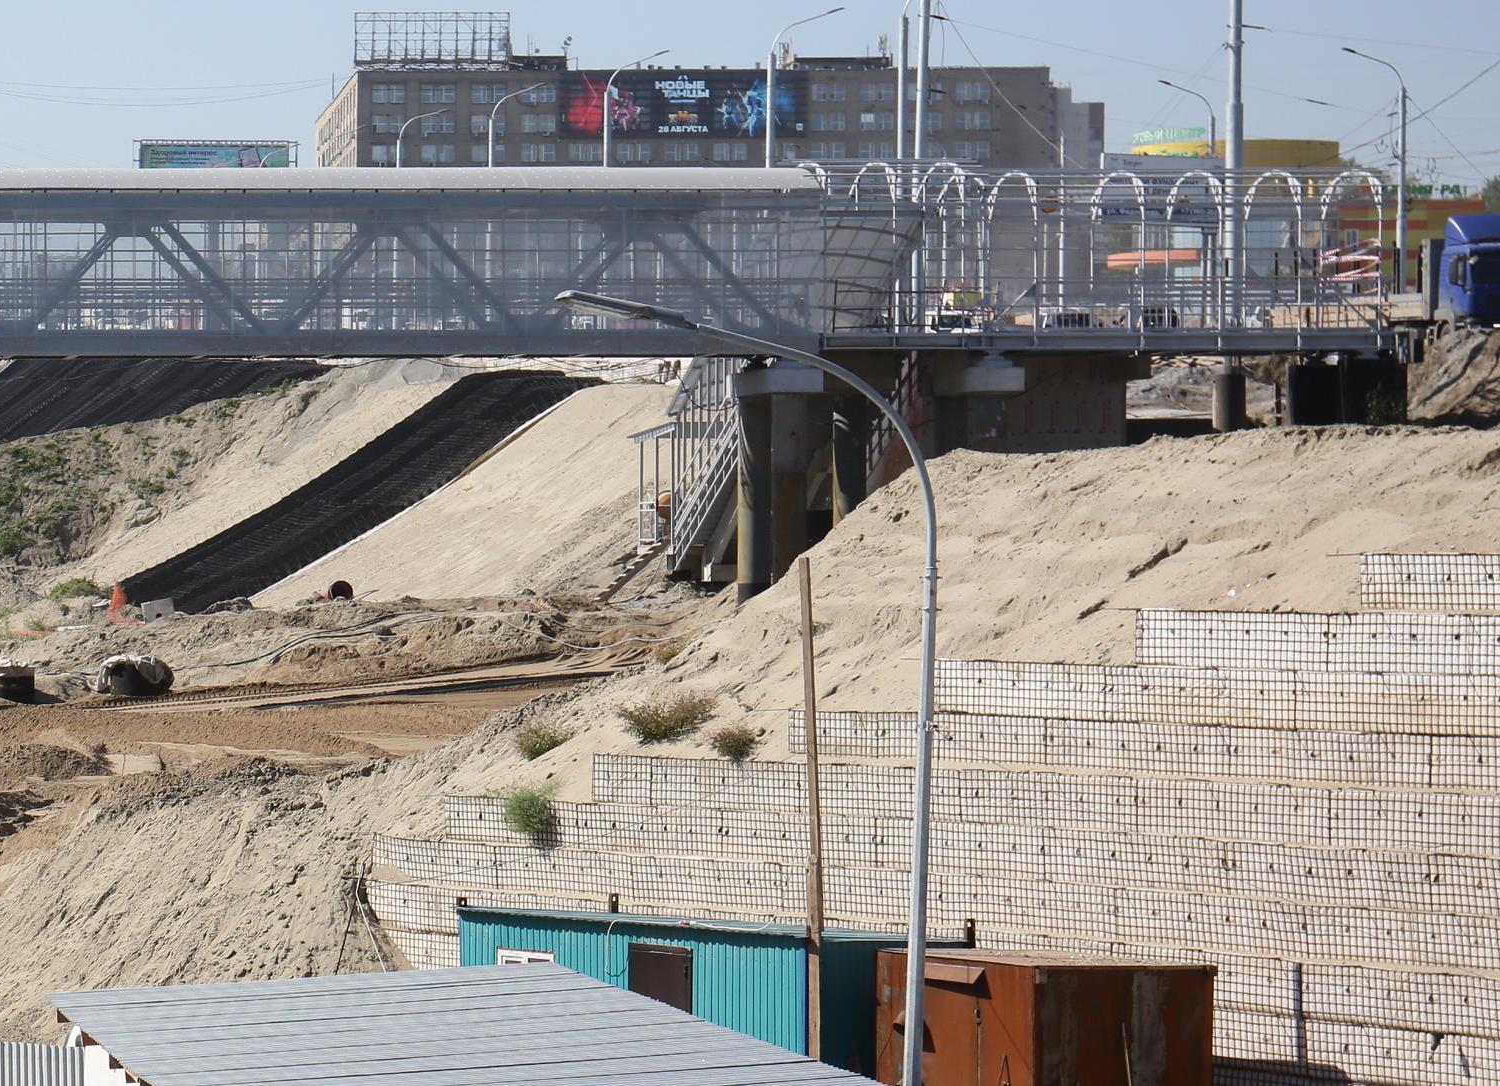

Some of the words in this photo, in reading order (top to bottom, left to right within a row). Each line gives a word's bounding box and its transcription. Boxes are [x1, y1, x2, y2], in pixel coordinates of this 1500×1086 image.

[655, 80, 705, 89] НОВЫЕ
[662, 89, 709, 98] ТАНЦЫ
[658, 125, 669, 133] 28
[670, 125, 709, 133] АВГУСТА
